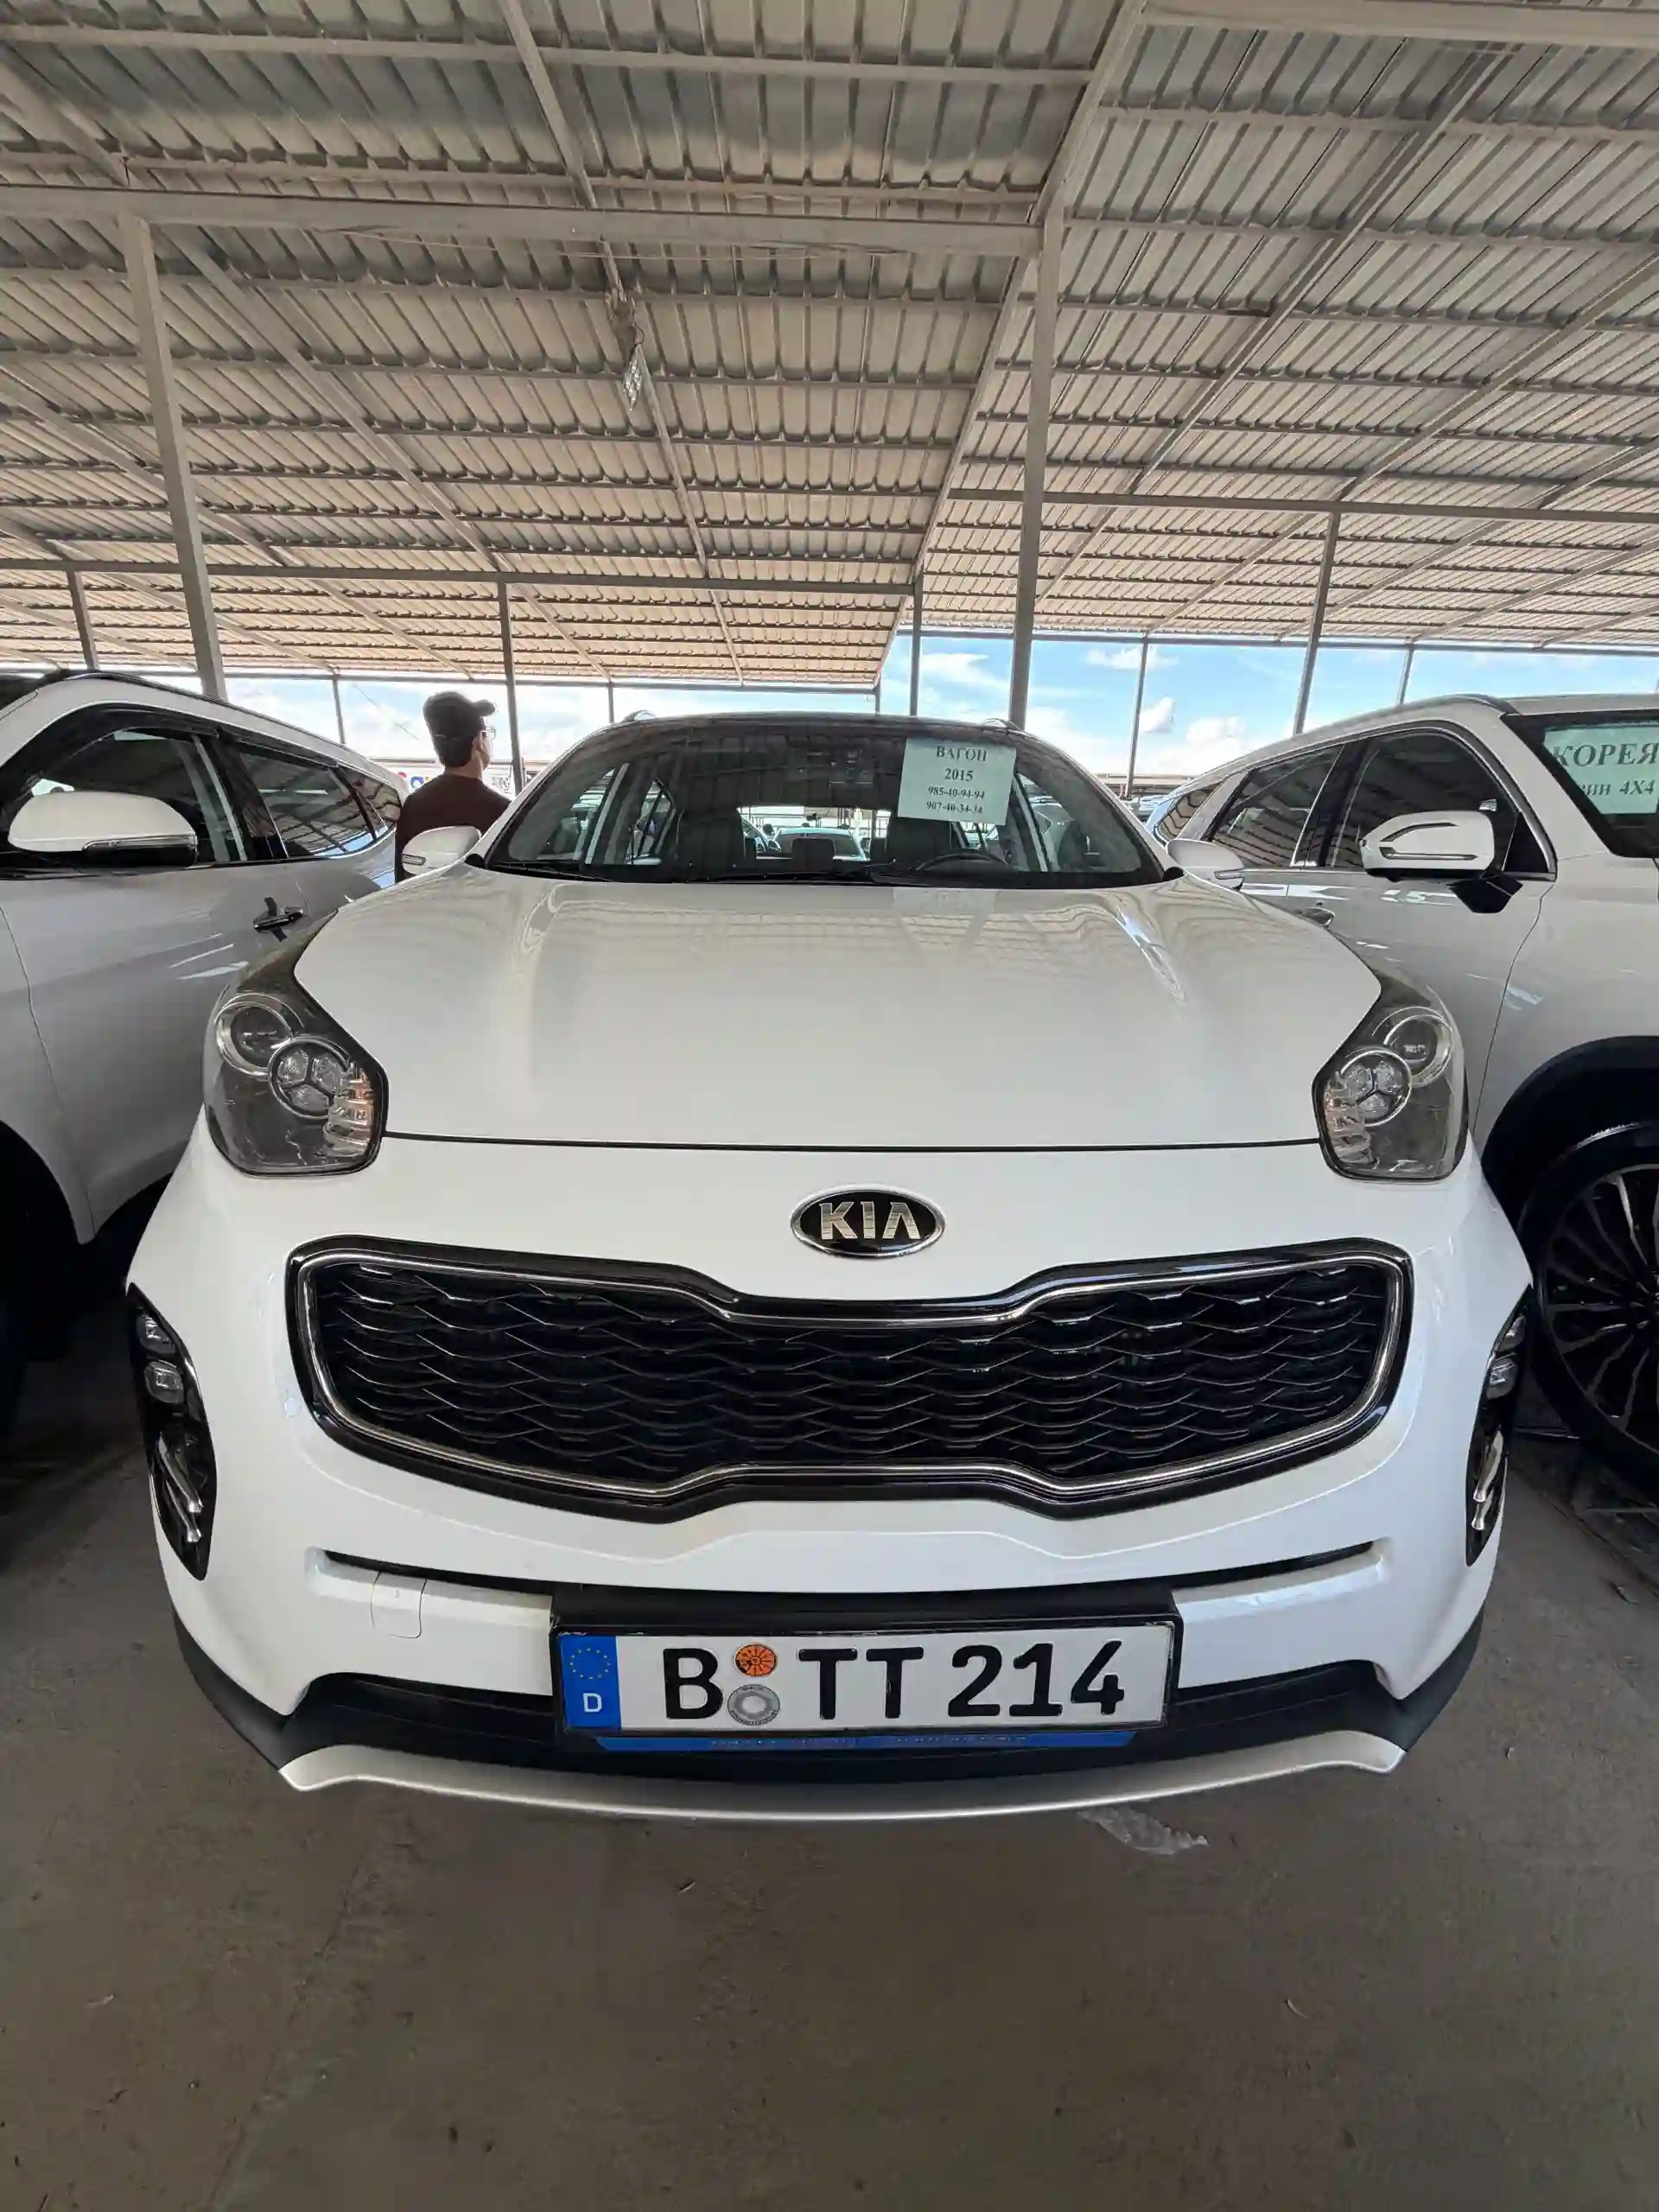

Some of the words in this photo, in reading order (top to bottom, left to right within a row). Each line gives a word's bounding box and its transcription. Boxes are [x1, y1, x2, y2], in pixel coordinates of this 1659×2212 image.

[936, 746, 987, 762] ВАГОН
[1553, 742, 1659, 766] КОРЕЯ
[944, 768, 974, 782] 2015
[819, 1201, 921, 1240] KIA
[663, 1648, 724, 1719] B
[798, 1646, 925, 1720] TT
[947, 1640, 1125, 1718] 214
[582, 1693, 602, 1713] D
